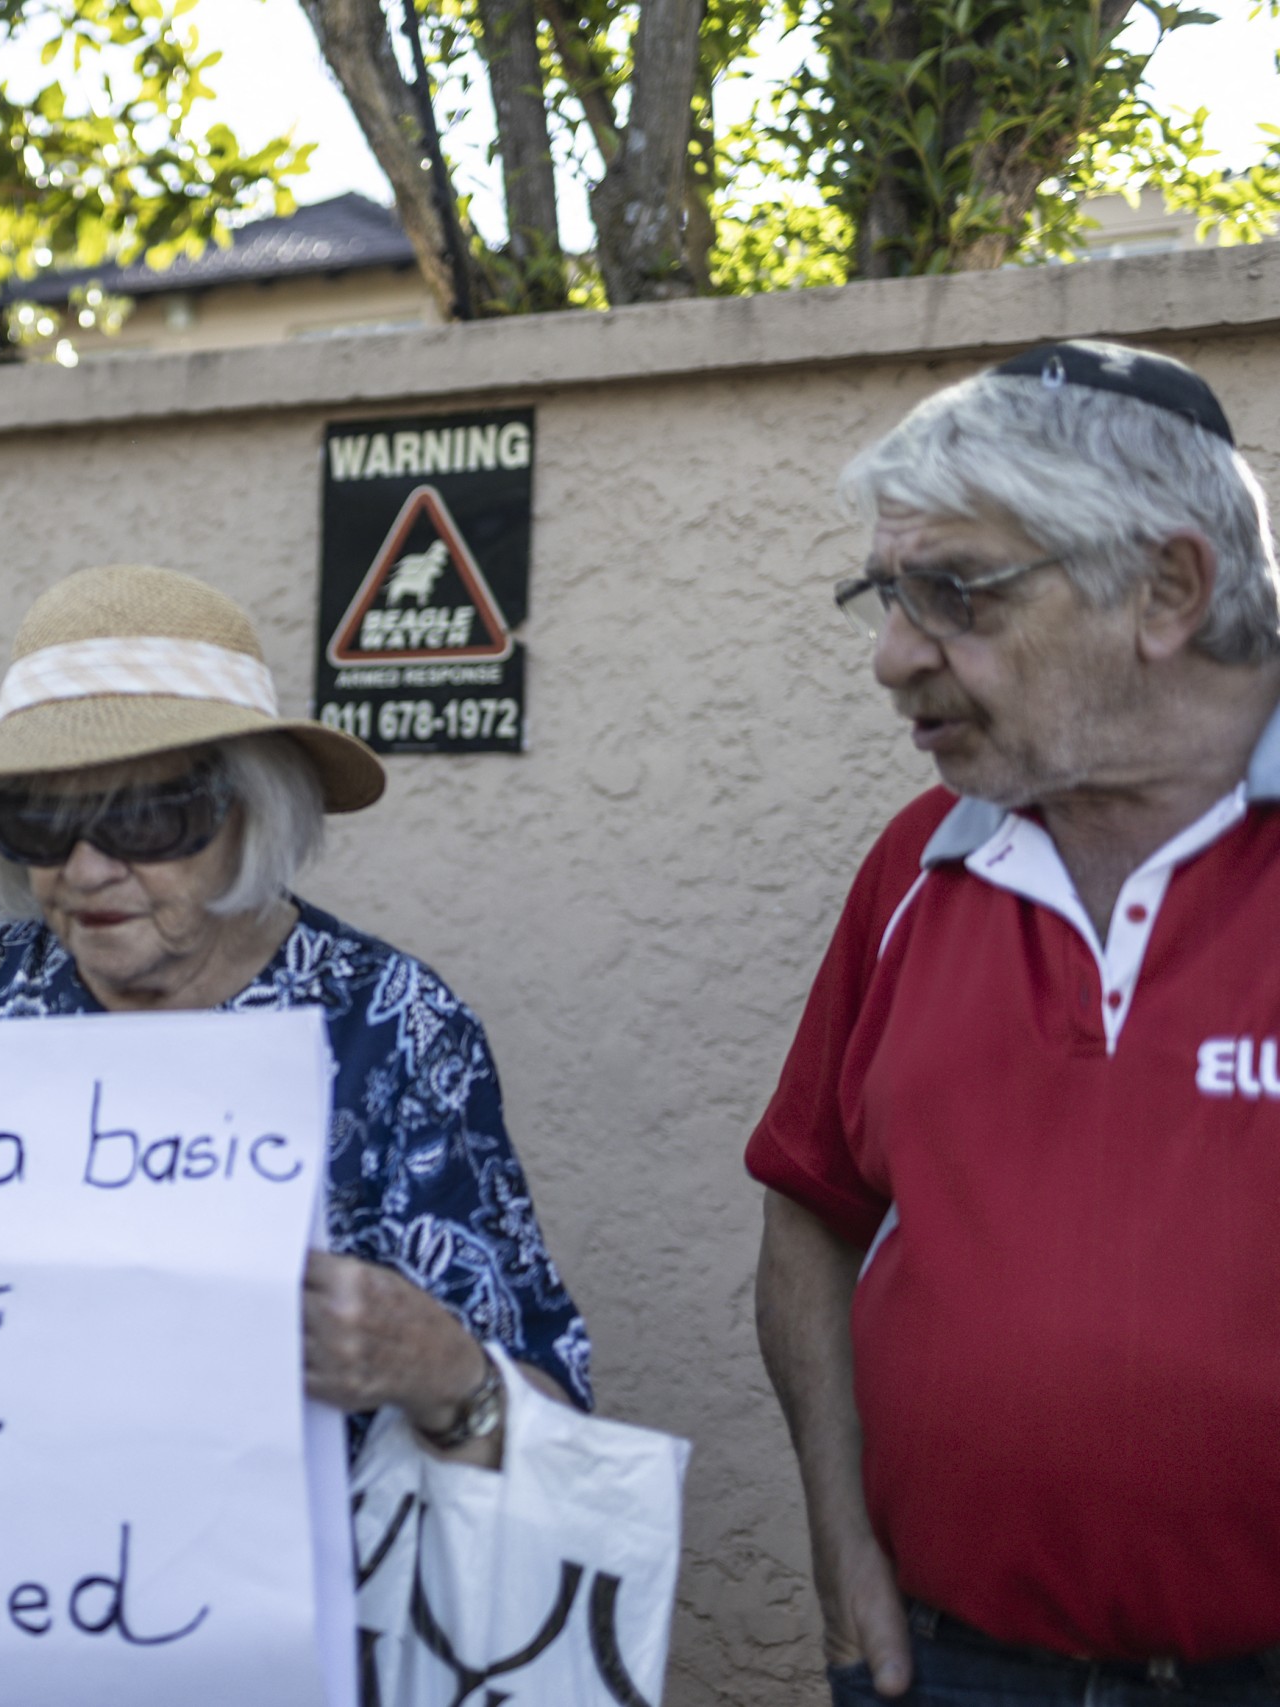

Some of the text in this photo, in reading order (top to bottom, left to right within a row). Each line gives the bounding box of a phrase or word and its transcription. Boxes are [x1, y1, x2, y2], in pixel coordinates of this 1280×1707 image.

[329, 421, 530, 482] WARNING
[362, 605, 474, 630] BEAGLE
[360, 628, 471, 651] WATCH
[335, 664, 503, 688] ARMED RESPONSE
[321, 697, 519, 740] 011 678-1972
[82, 1079, 304, 1191] basic
